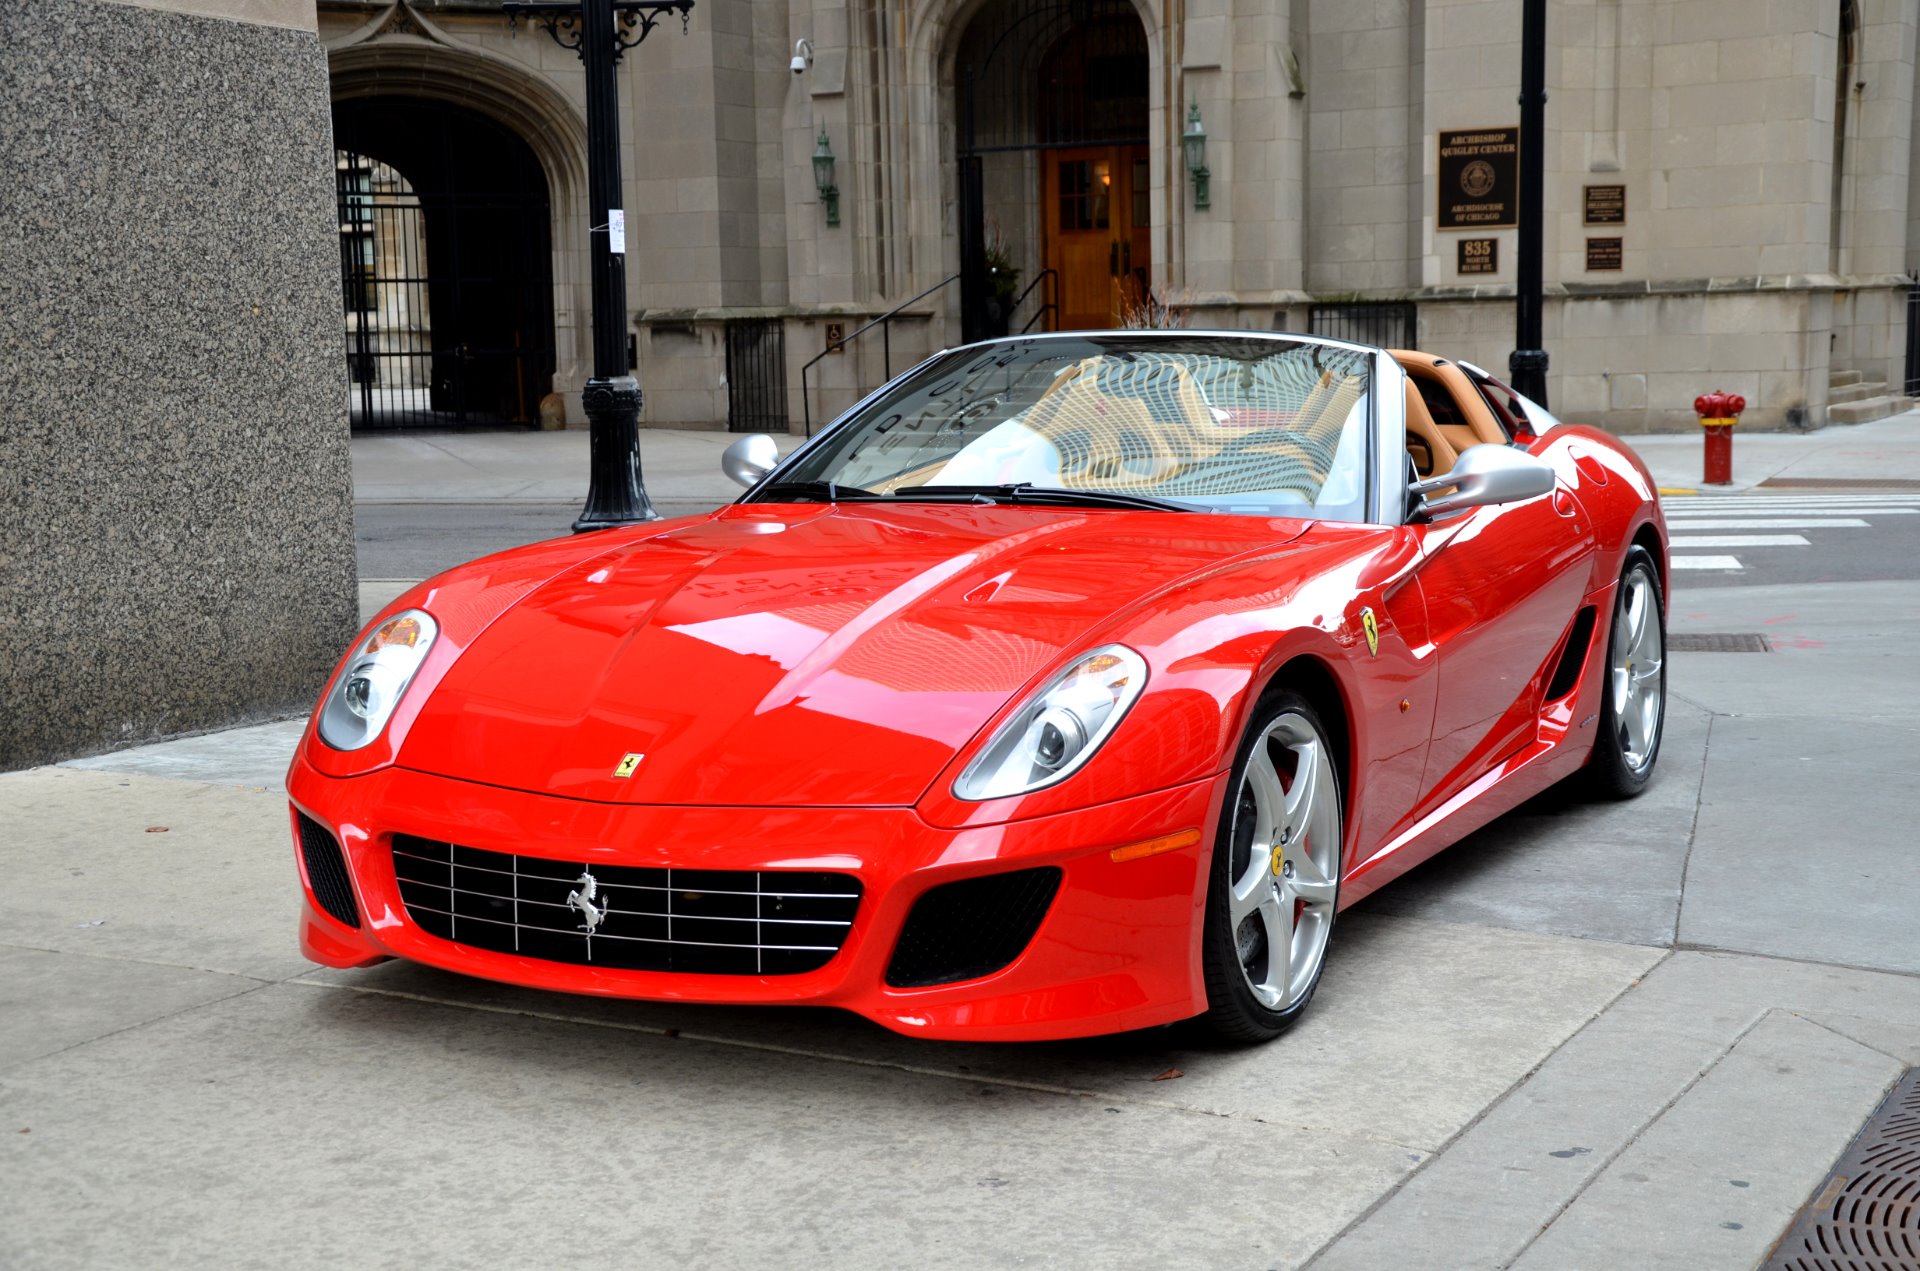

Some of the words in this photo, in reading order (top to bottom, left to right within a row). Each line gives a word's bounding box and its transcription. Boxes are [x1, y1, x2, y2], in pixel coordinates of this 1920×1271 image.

[1451, 133, 1506, 145] ARCHBISHOP
[1441, 146, 1479, 157] QUIGLEY
[1480, 144, 1515, 154] CENTER
[1452, 203, 1504, 212] ARCHDIOCESE
[1455, 213, 1464, 221] OF
[1466, 213, 1500, 221] CHICAGO
[1465, 241, 1491, 255] 835
